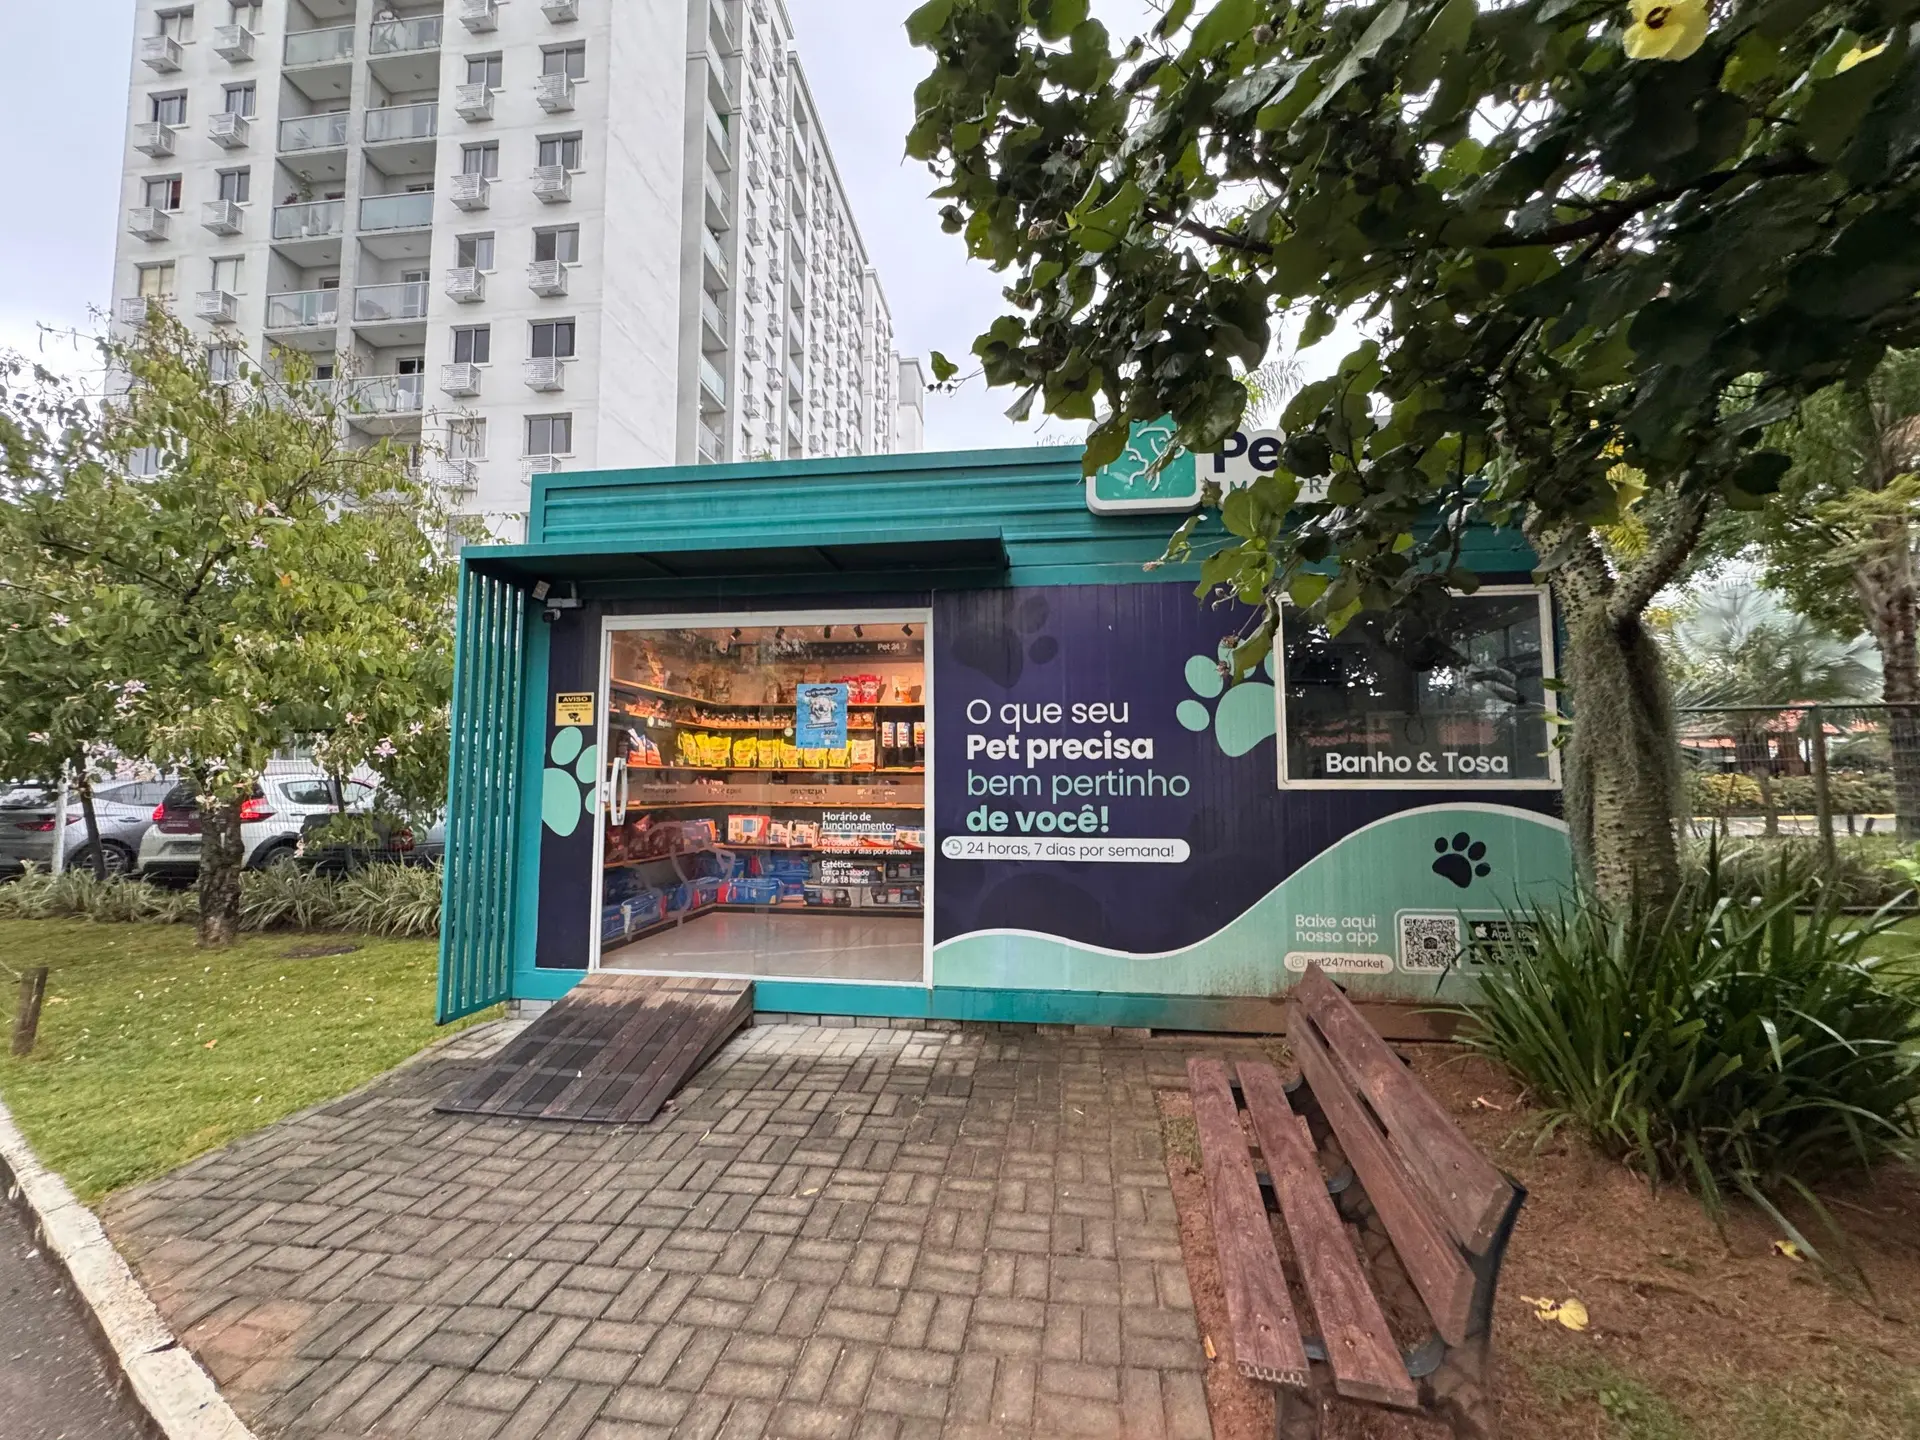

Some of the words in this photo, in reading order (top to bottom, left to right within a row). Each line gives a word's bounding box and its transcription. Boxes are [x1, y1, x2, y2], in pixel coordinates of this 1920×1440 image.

[966, 698, 992, 725] O
[999, 702, 1063, 732] que
[1071, 701, 1129, 724] seu
[966, 734, 1020, 760] Pet
[1027, 730, 1154, 769] precisa
[1326, 751, 1411, 773] Banho
[1416, 751, 1438, 773] &
[1442, 751, 1508, 773] Tosa
[967, 769, 1042, 796] bem
[1052, 767, 1190, 804] pertinho
[822, 811, 858, 821] Horário
[859, 811, 871, 821] de
[966, 804, 1009, 832] de
[1015, 803, 1110, 833] você!
[822, 821, 895, 831] funcionamento:
[967, 842, 984, 854] 24
[988, 842, 1031, 857] horas,
[1034, 843, 1043, 855] 7
[1046, 843, 1076, 856] dias
[1080, 845, 1104, 860] por
[1108, 845, 1175, 857] semana!
[821, 868, 839, 876] Terça
[822, 860, 853, 869] Estética:
[1295, 913, 1337, 928] Baixe
[1341, 914, 1376, 931] aqui
[1296, 930, 1342, 943] nosso
[1346, 931, 1379, 947] app
